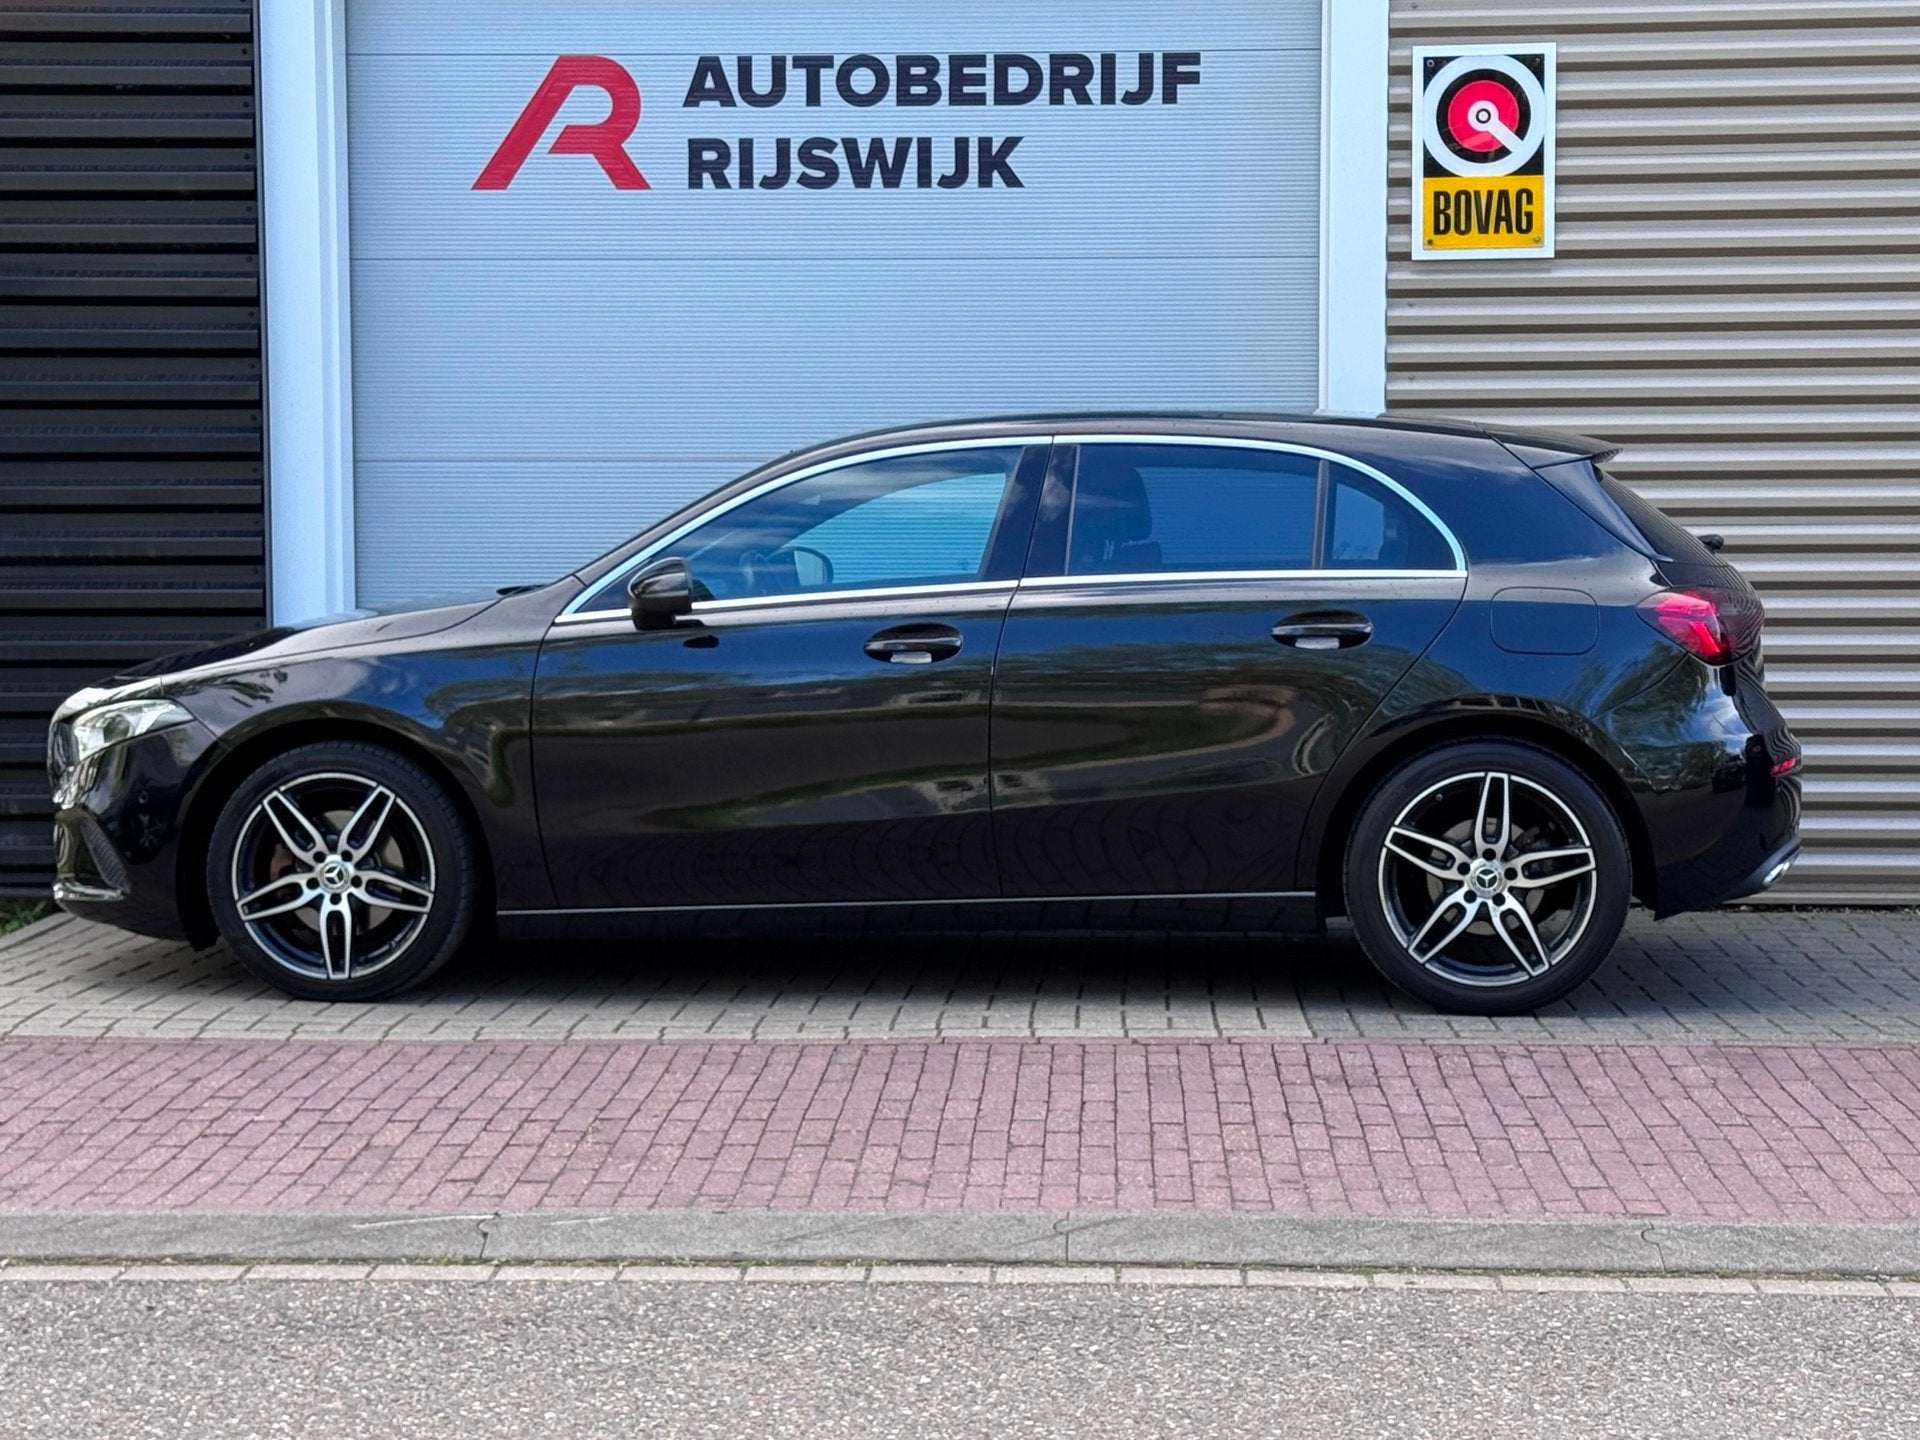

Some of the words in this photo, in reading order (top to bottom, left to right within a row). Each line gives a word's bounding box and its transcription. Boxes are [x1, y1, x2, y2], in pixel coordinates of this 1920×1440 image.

[683, 52, 1201, 108] AUTOBEDRIJF
[687, 136, 1025, 190] RIJSWIJK
[1433, 188, 1534, 236] BOVAG
